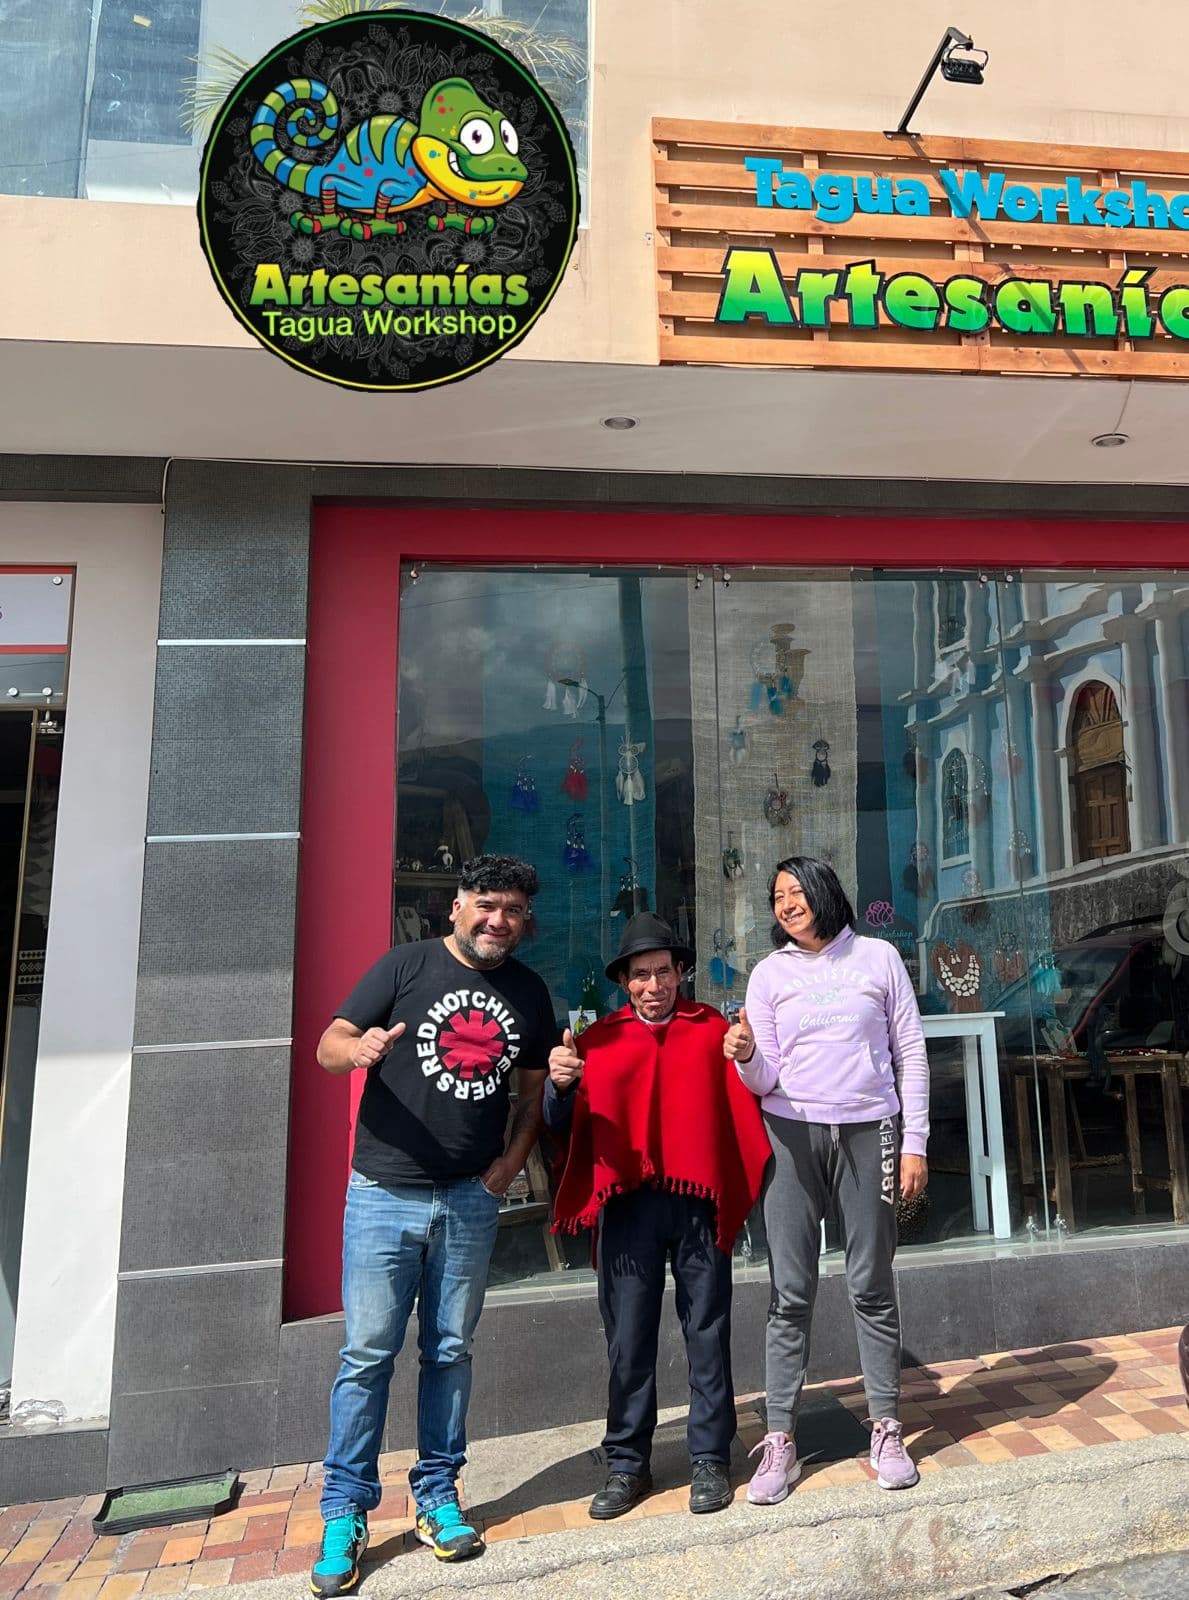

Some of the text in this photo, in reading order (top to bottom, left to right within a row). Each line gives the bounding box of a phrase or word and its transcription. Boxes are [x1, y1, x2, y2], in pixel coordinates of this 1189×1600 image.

[744, 156, 931, 224] Tagua
[427, 989, 471, 1024] HOT
[471, 991, 521, 1040] CHILI
[800, 1013, 861, 1031] California
[416, 1022, 443, 1077] RED
[880, 1145, 895, 1206] 1987
